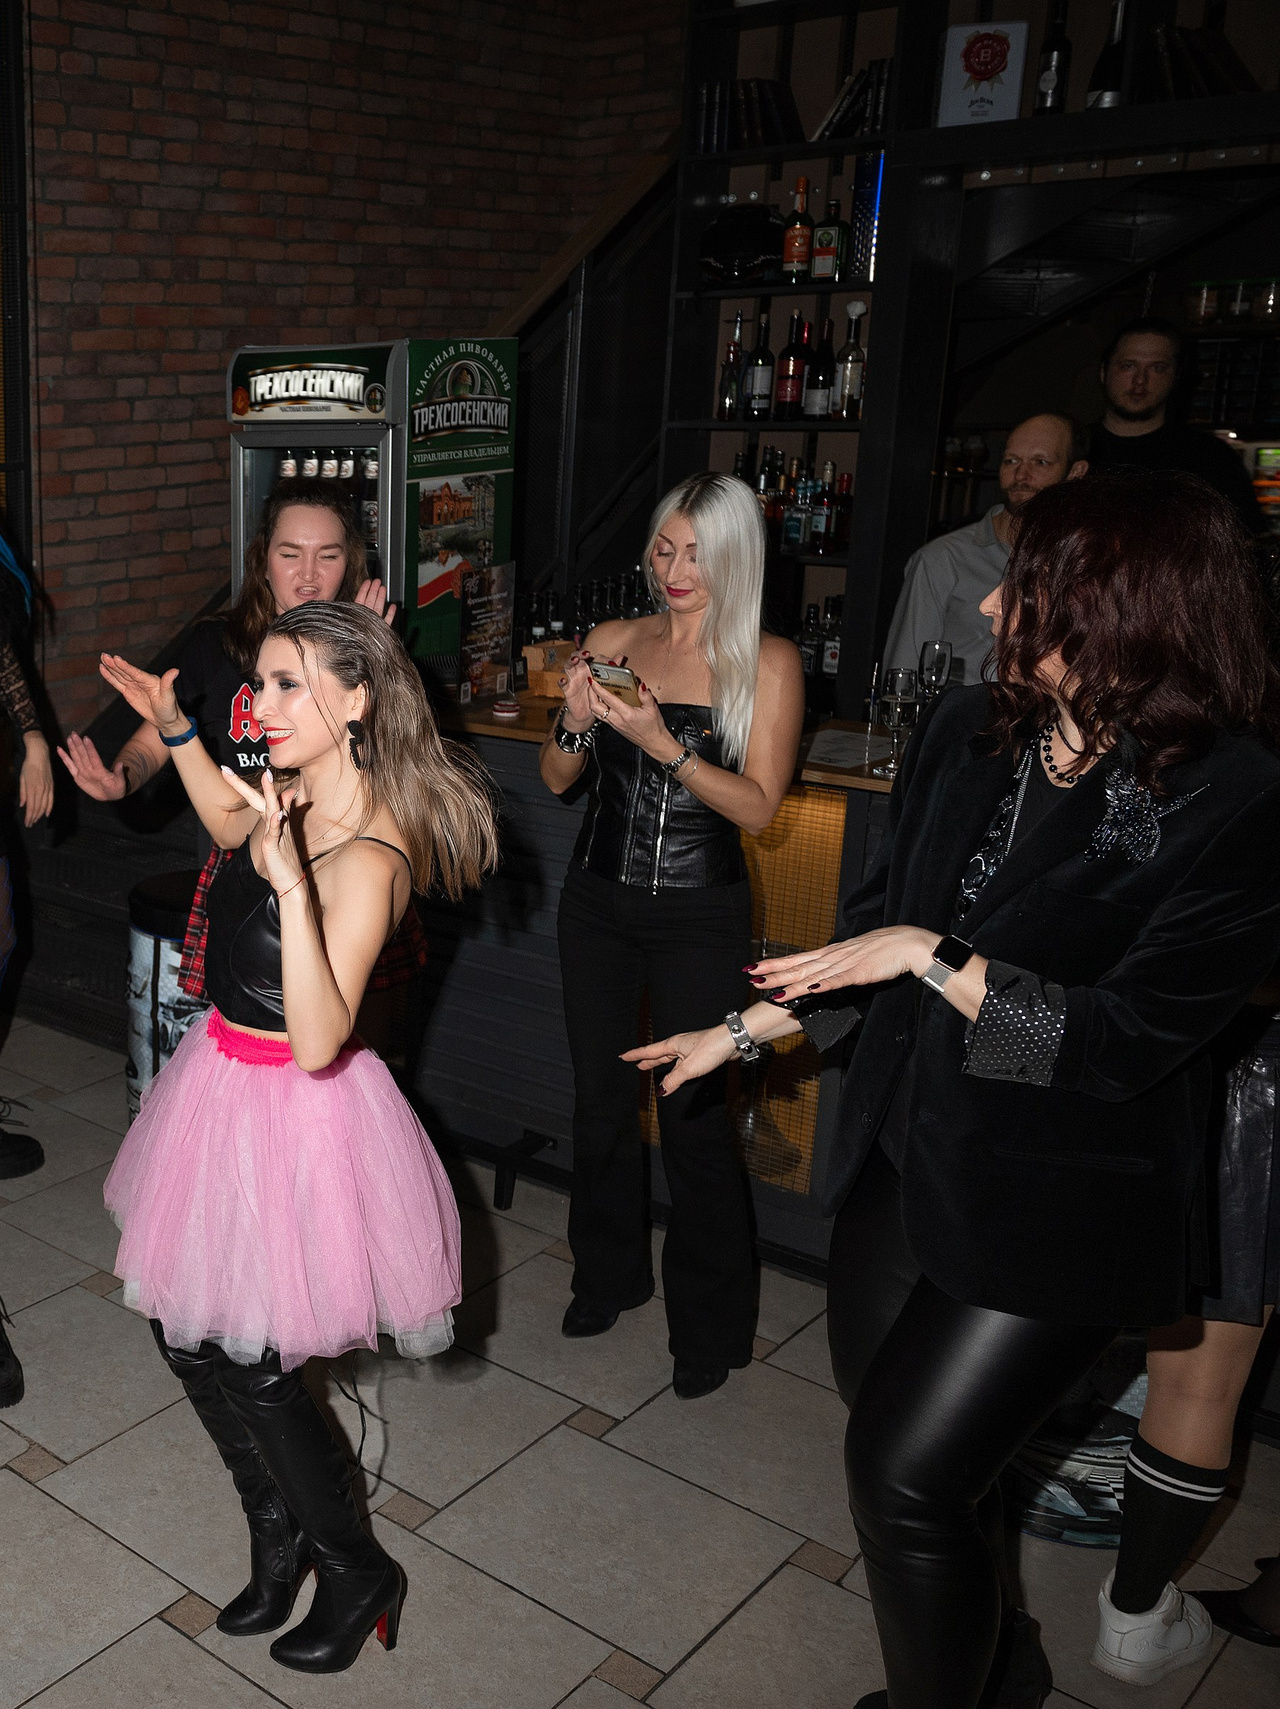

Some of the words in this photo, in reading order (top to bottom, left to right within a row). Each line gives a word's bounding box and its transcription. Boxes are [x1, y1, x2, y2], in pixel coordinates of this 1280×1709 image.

[414, 345, 456, 397] ЧАСТНАЯ
[459, 342, 511, 392] ПИВОВАРНЯ
[413, 400, 509, 435] ТРЕХСОСЕНСКИЙ
[412, 449, 463, 463] УПРАВЛЯЕТСЯ
[463, 445, 510, 460] ВЛАДЕЛЬЦЕМ
